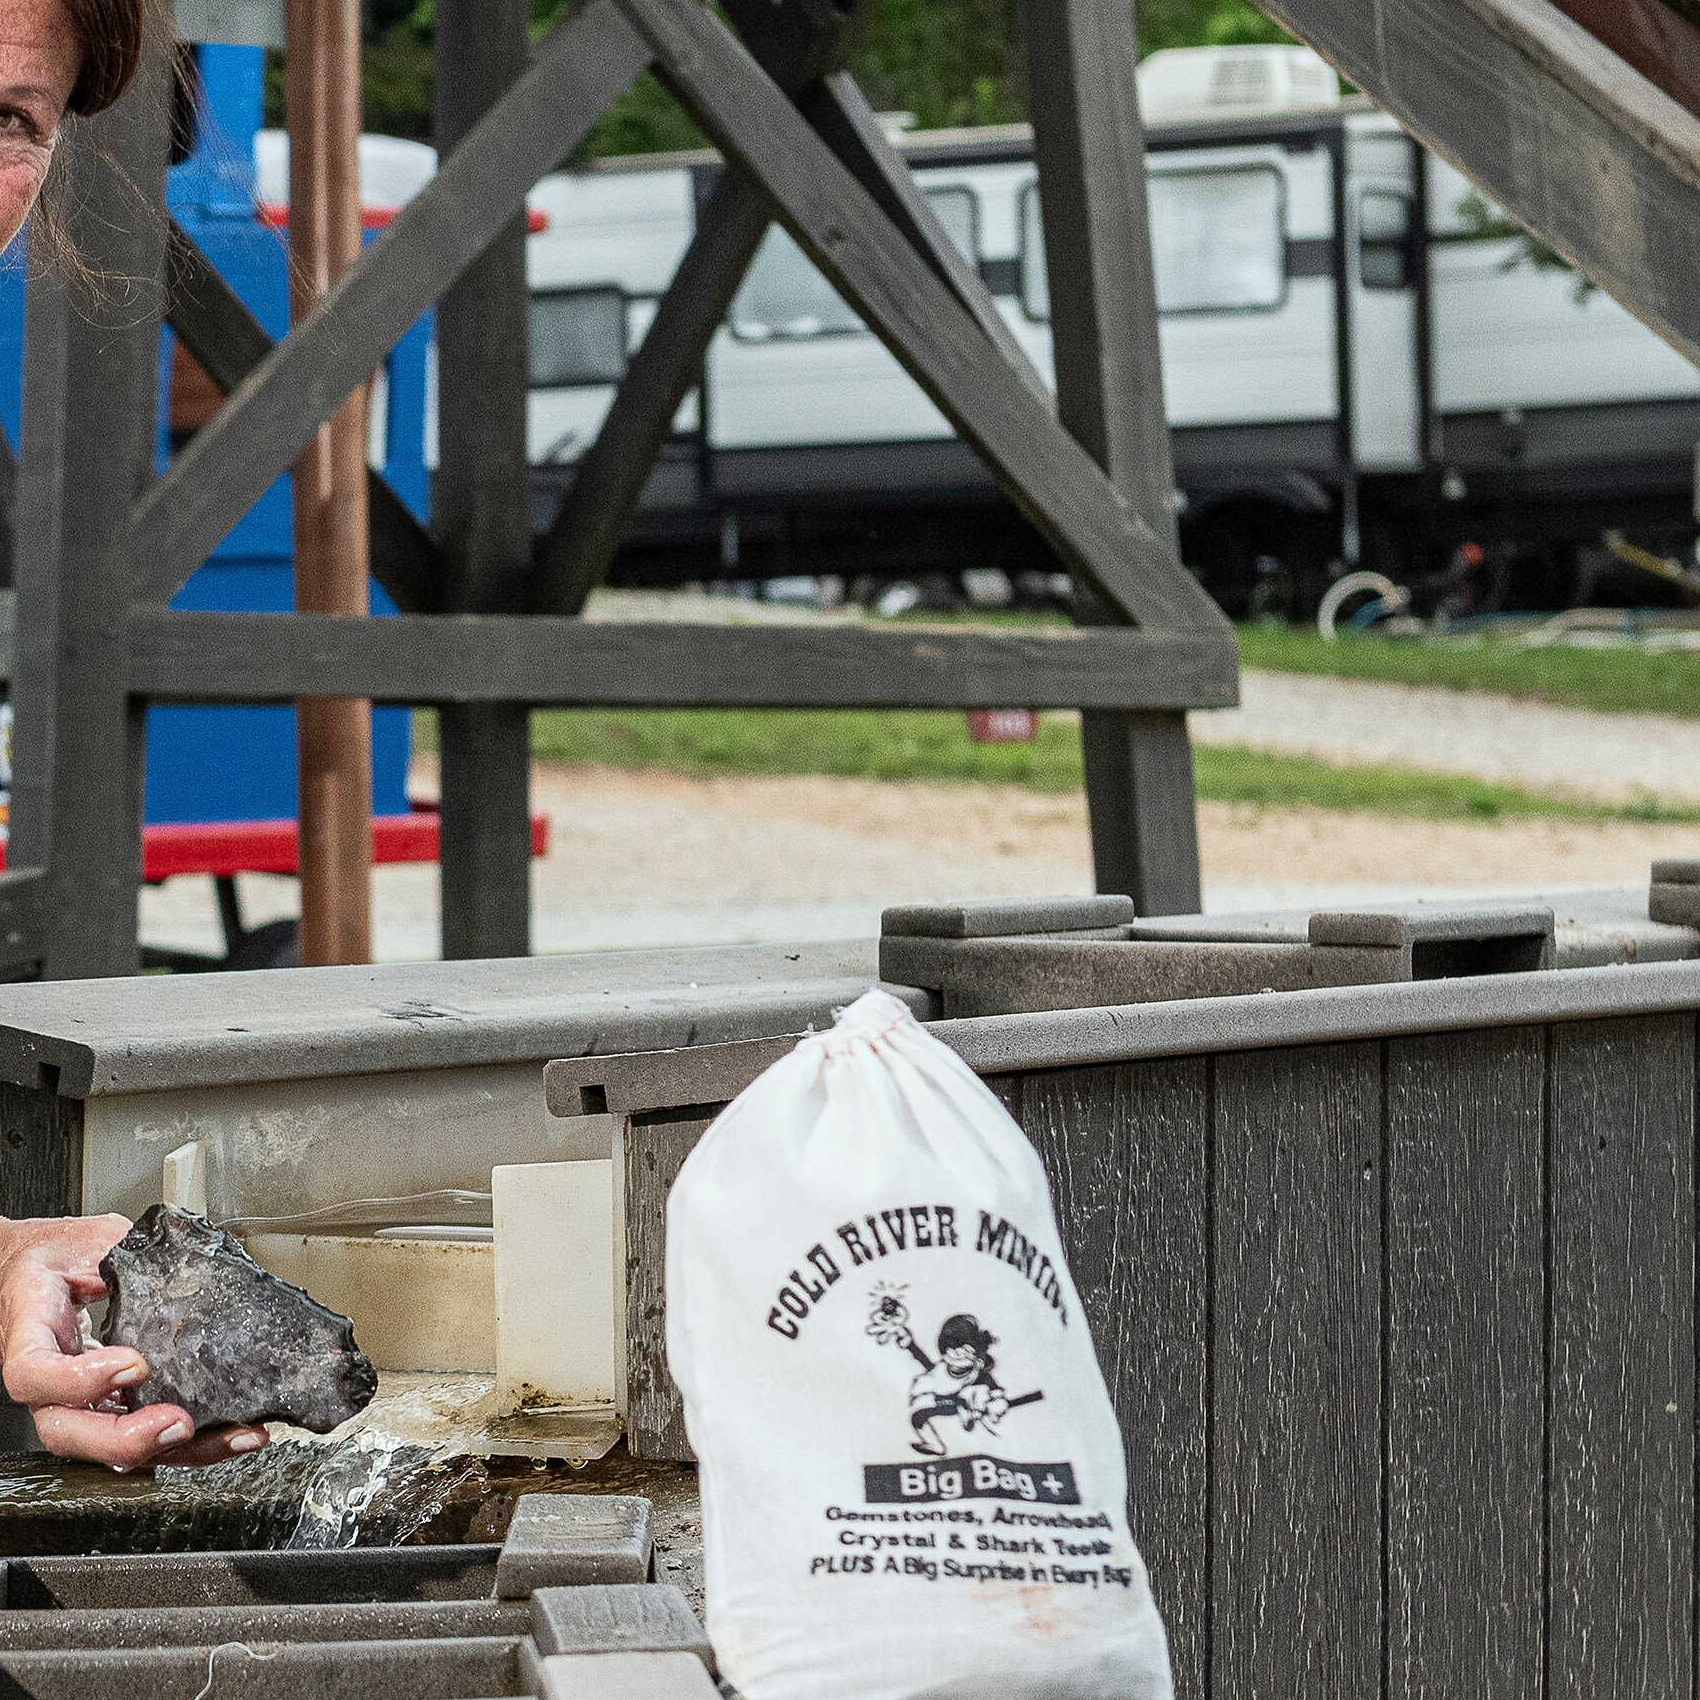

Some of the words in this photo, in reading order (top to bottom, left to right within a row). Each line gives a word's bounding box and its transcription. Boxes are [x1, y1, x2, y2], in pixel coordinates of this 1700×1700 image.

[767, 1243, 842, 1340] COLD
[836, 1204, 958, 1266] RIVER
[976, 1209, 1068, 1327] MININ
[900, 1464, 963, 1500] Big
[971, 1458, 1038, 1501] Bag
[825, 1506, 983, 1527] Gemstones,
[840, 1530, 936, 1550] Crystal
[948, 1533, 966, 1549] &
[976, 1533, 1046, 1554] Shark
[811, 1554, 875, 1575] PLUS
[884, 1555, 900, 1574] A
[904, 1555, 938, 1581] Big
[943, 1558, 1025, 1584] Surprise
